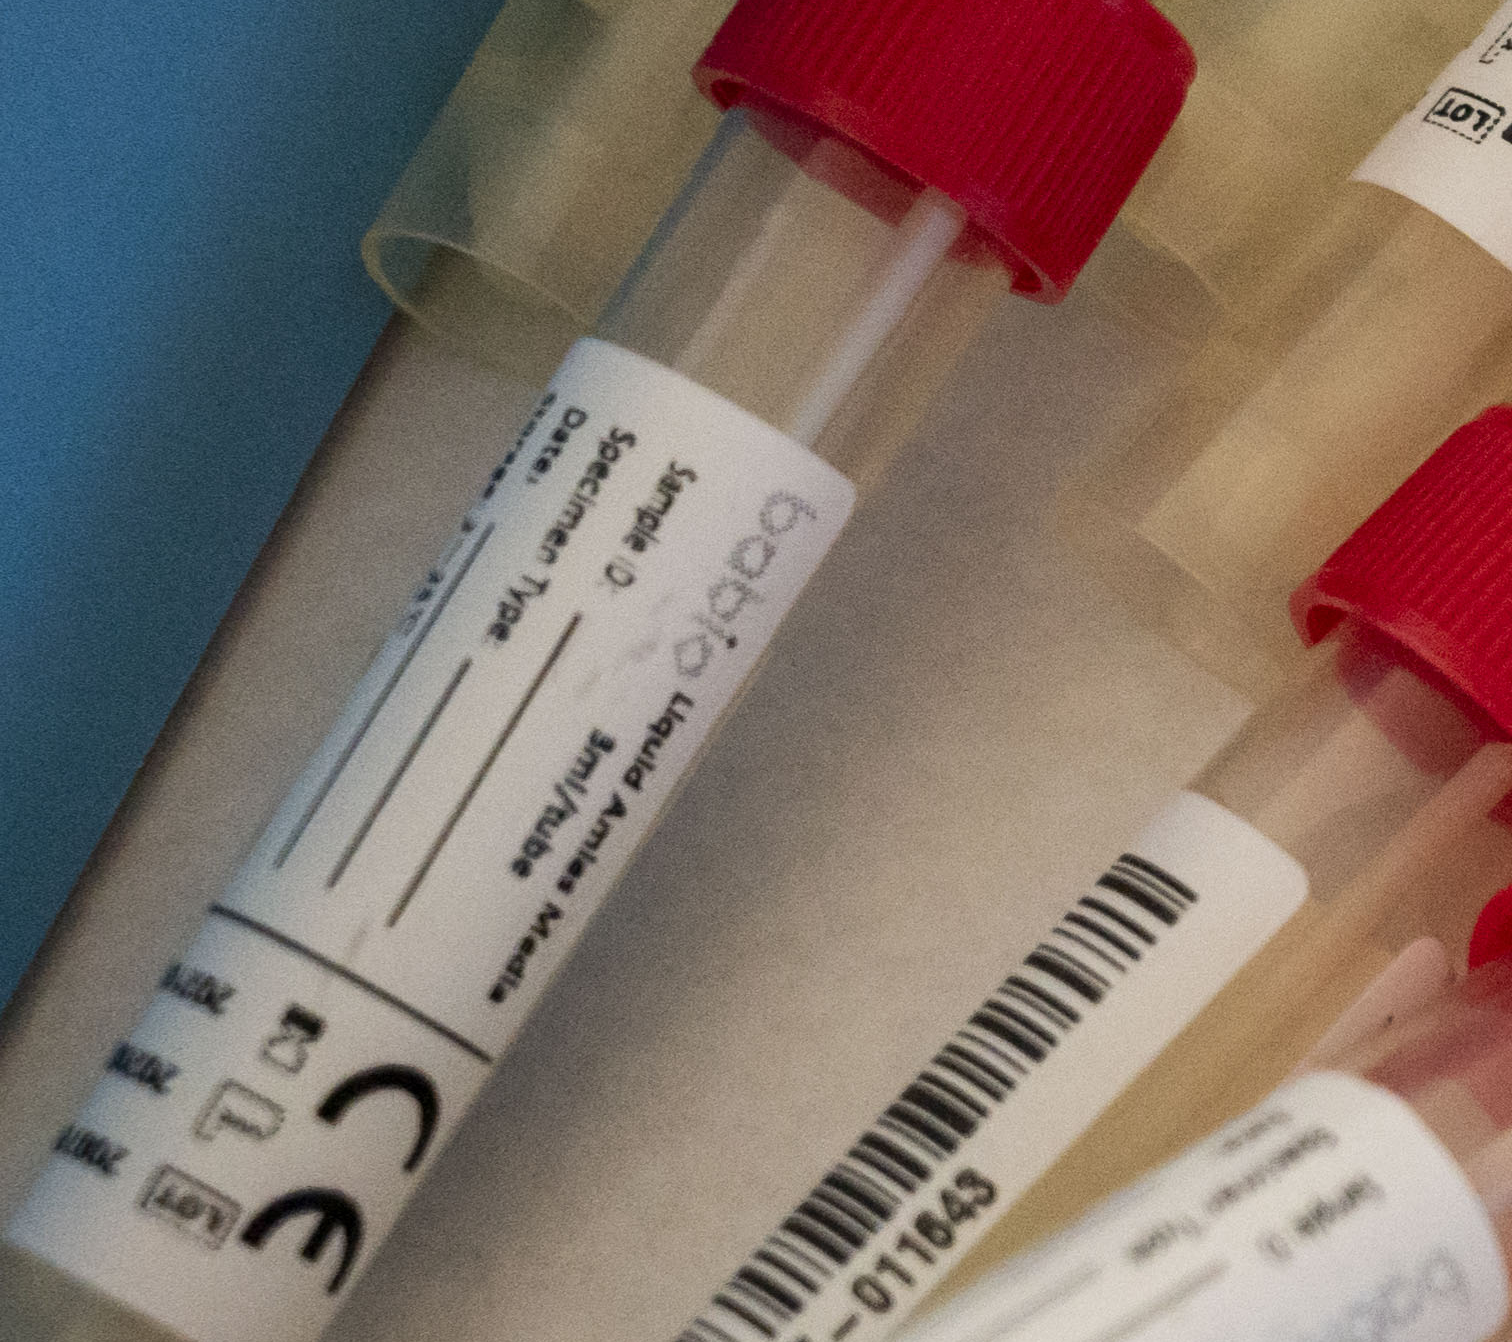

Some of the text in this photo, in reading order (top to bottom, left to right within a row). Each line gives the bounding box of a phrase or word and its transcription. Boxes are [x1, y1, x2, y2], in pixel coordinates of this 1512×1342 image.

[1432, 93, 1492, 136] LOT
[534, 423, 639, 569] Specimen
[618, 458, 699, 557] Sample
[510, 729, 617, 880] 3ml/tube
